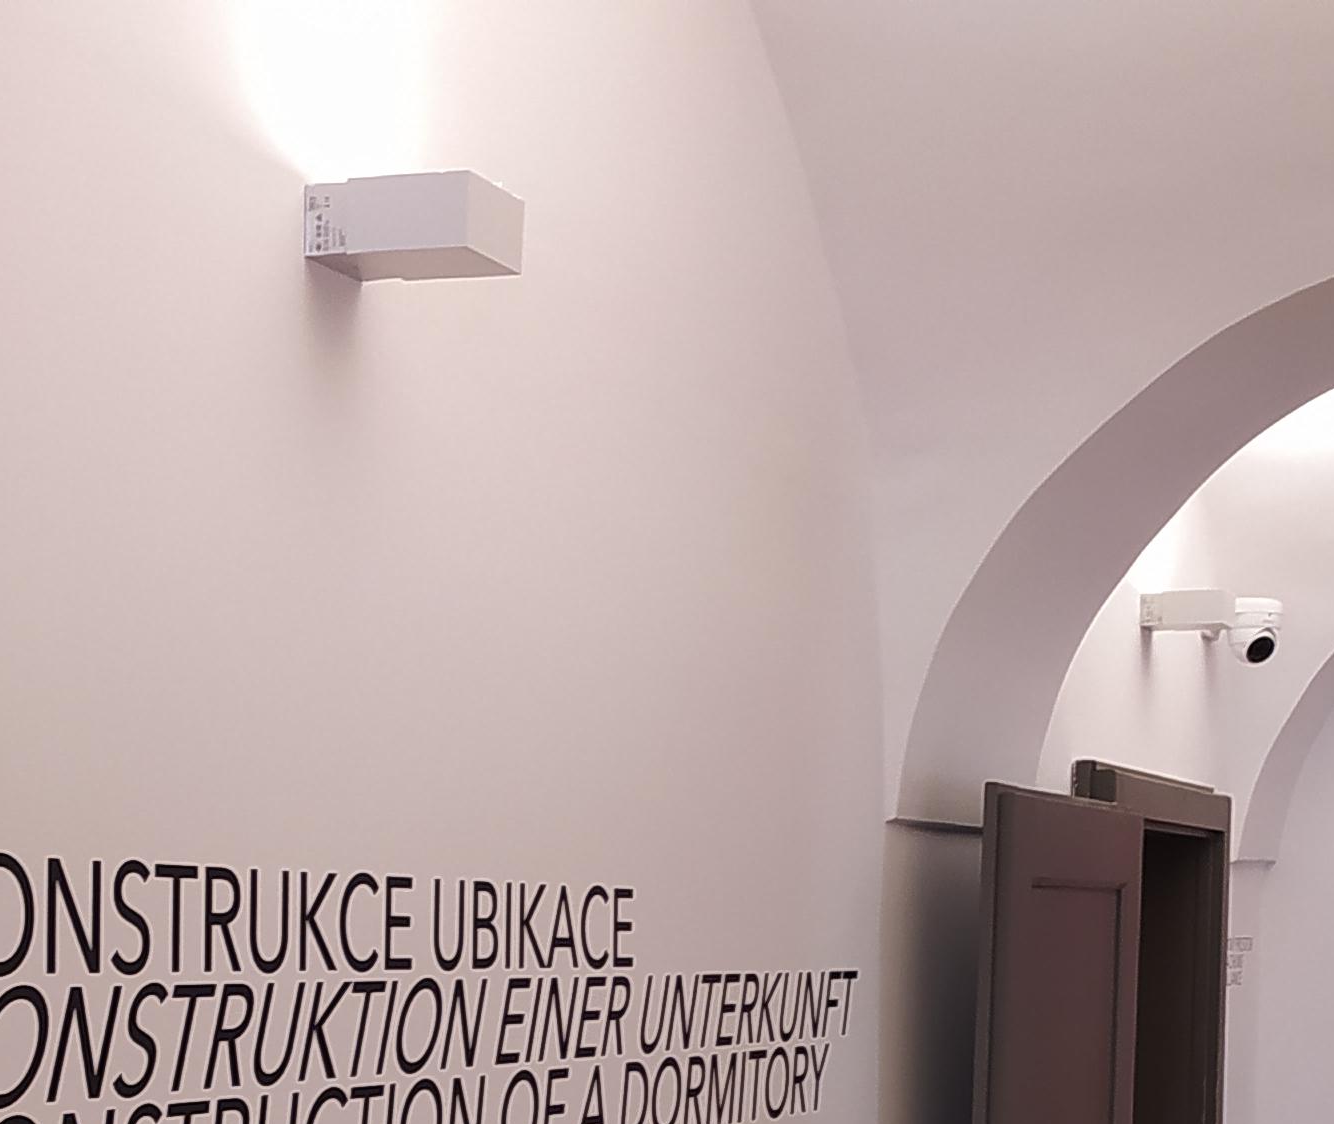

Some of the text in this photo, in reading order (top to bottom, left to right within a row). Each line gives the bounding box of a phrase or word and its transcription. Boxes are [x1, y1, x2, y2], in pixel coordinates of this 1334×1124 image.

[433, 878, 634, 972] UBIKACE
[494, 975, 631, 1066] EINER
[640, 970, 859, 1056] UNTERKUNFT
